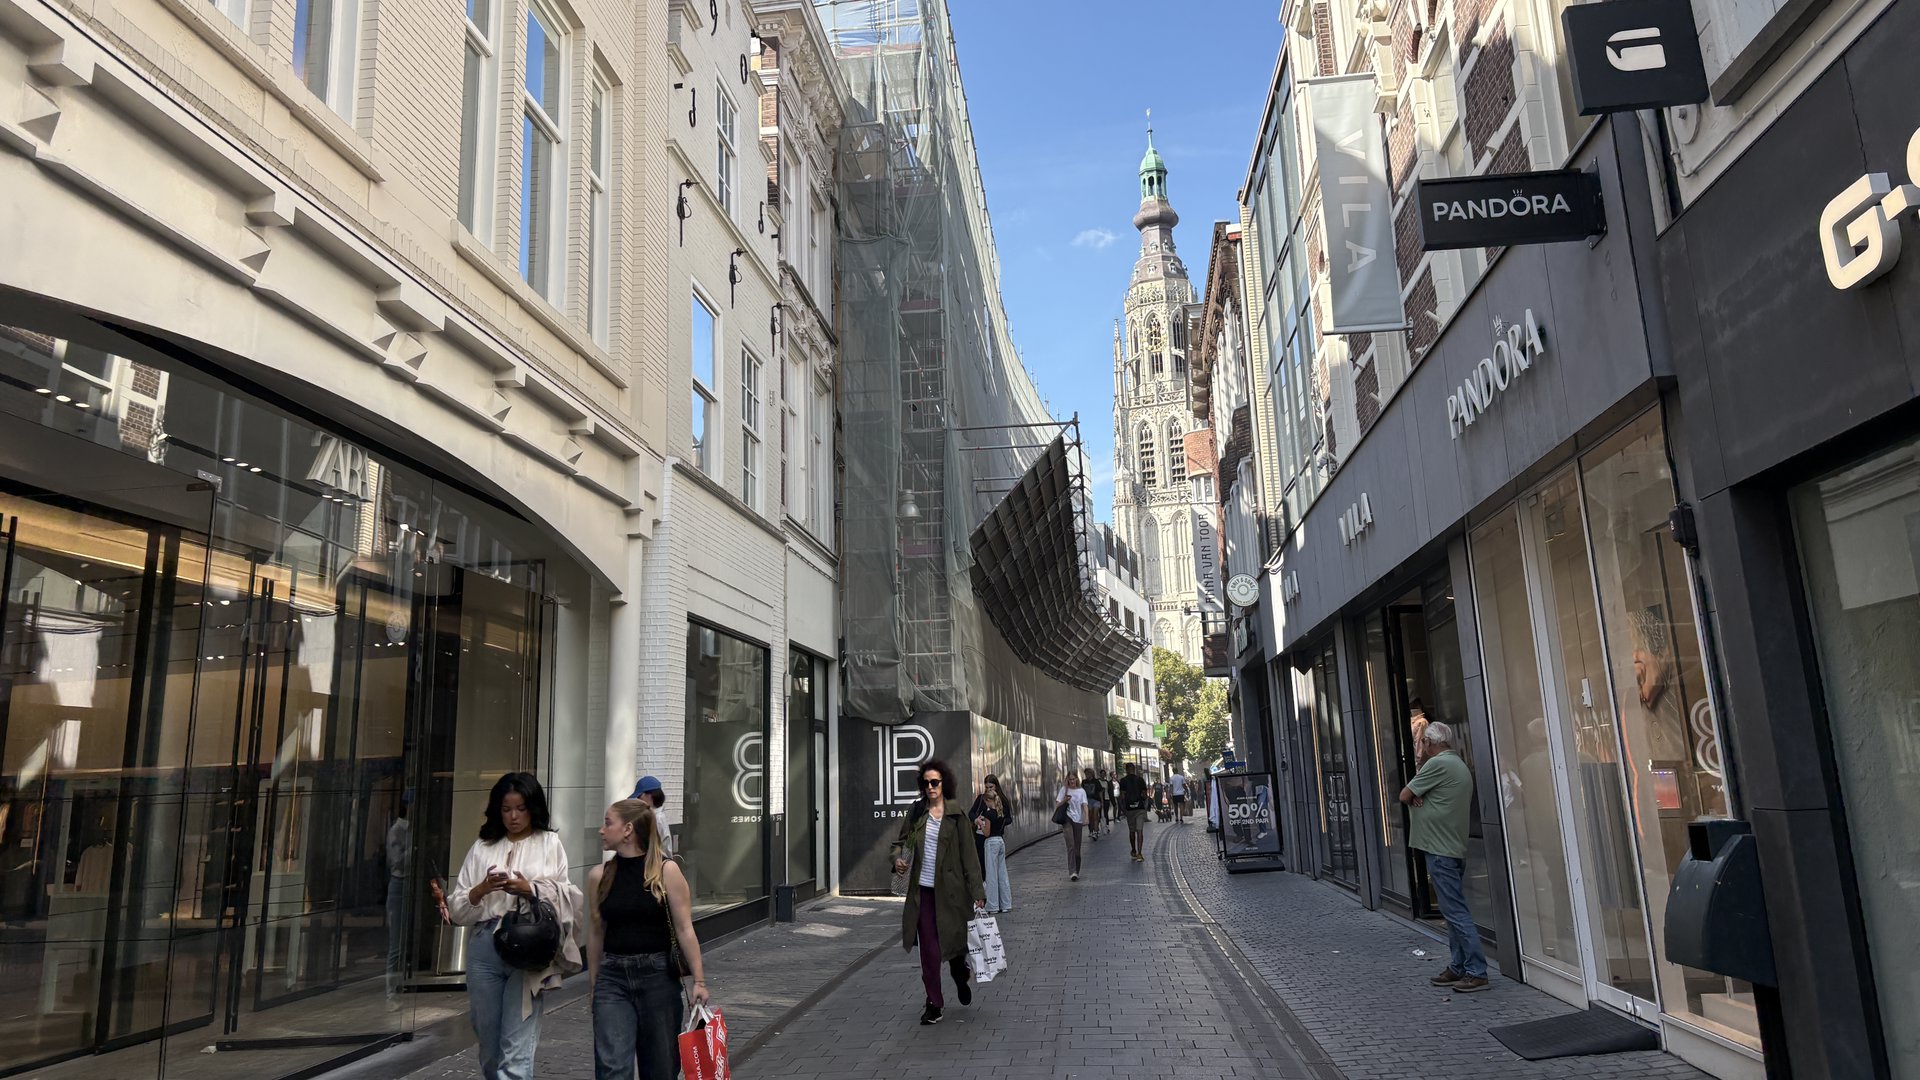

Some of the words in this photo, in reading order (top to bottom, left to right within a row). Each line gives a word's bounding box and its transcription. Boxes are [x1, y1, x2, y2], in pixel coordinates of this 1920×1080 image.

[1335, 129, 1377, 274] VILA
[1432, 192, 1571, 222] PANDORA
[1819, 125, 1920, 290] G-
[1446, 308, 1546, 440] PANDORA
[306, 431, 373, 502] ZARA
[1198, 512, 1210, 542] TOOR
[1338, 492, 1373, 546] VILA
[1200, 545, 1213, 568] VAN
[1203, 572, 1215, 604] ANNA
[1228, 801, 1268, 819] 50%
